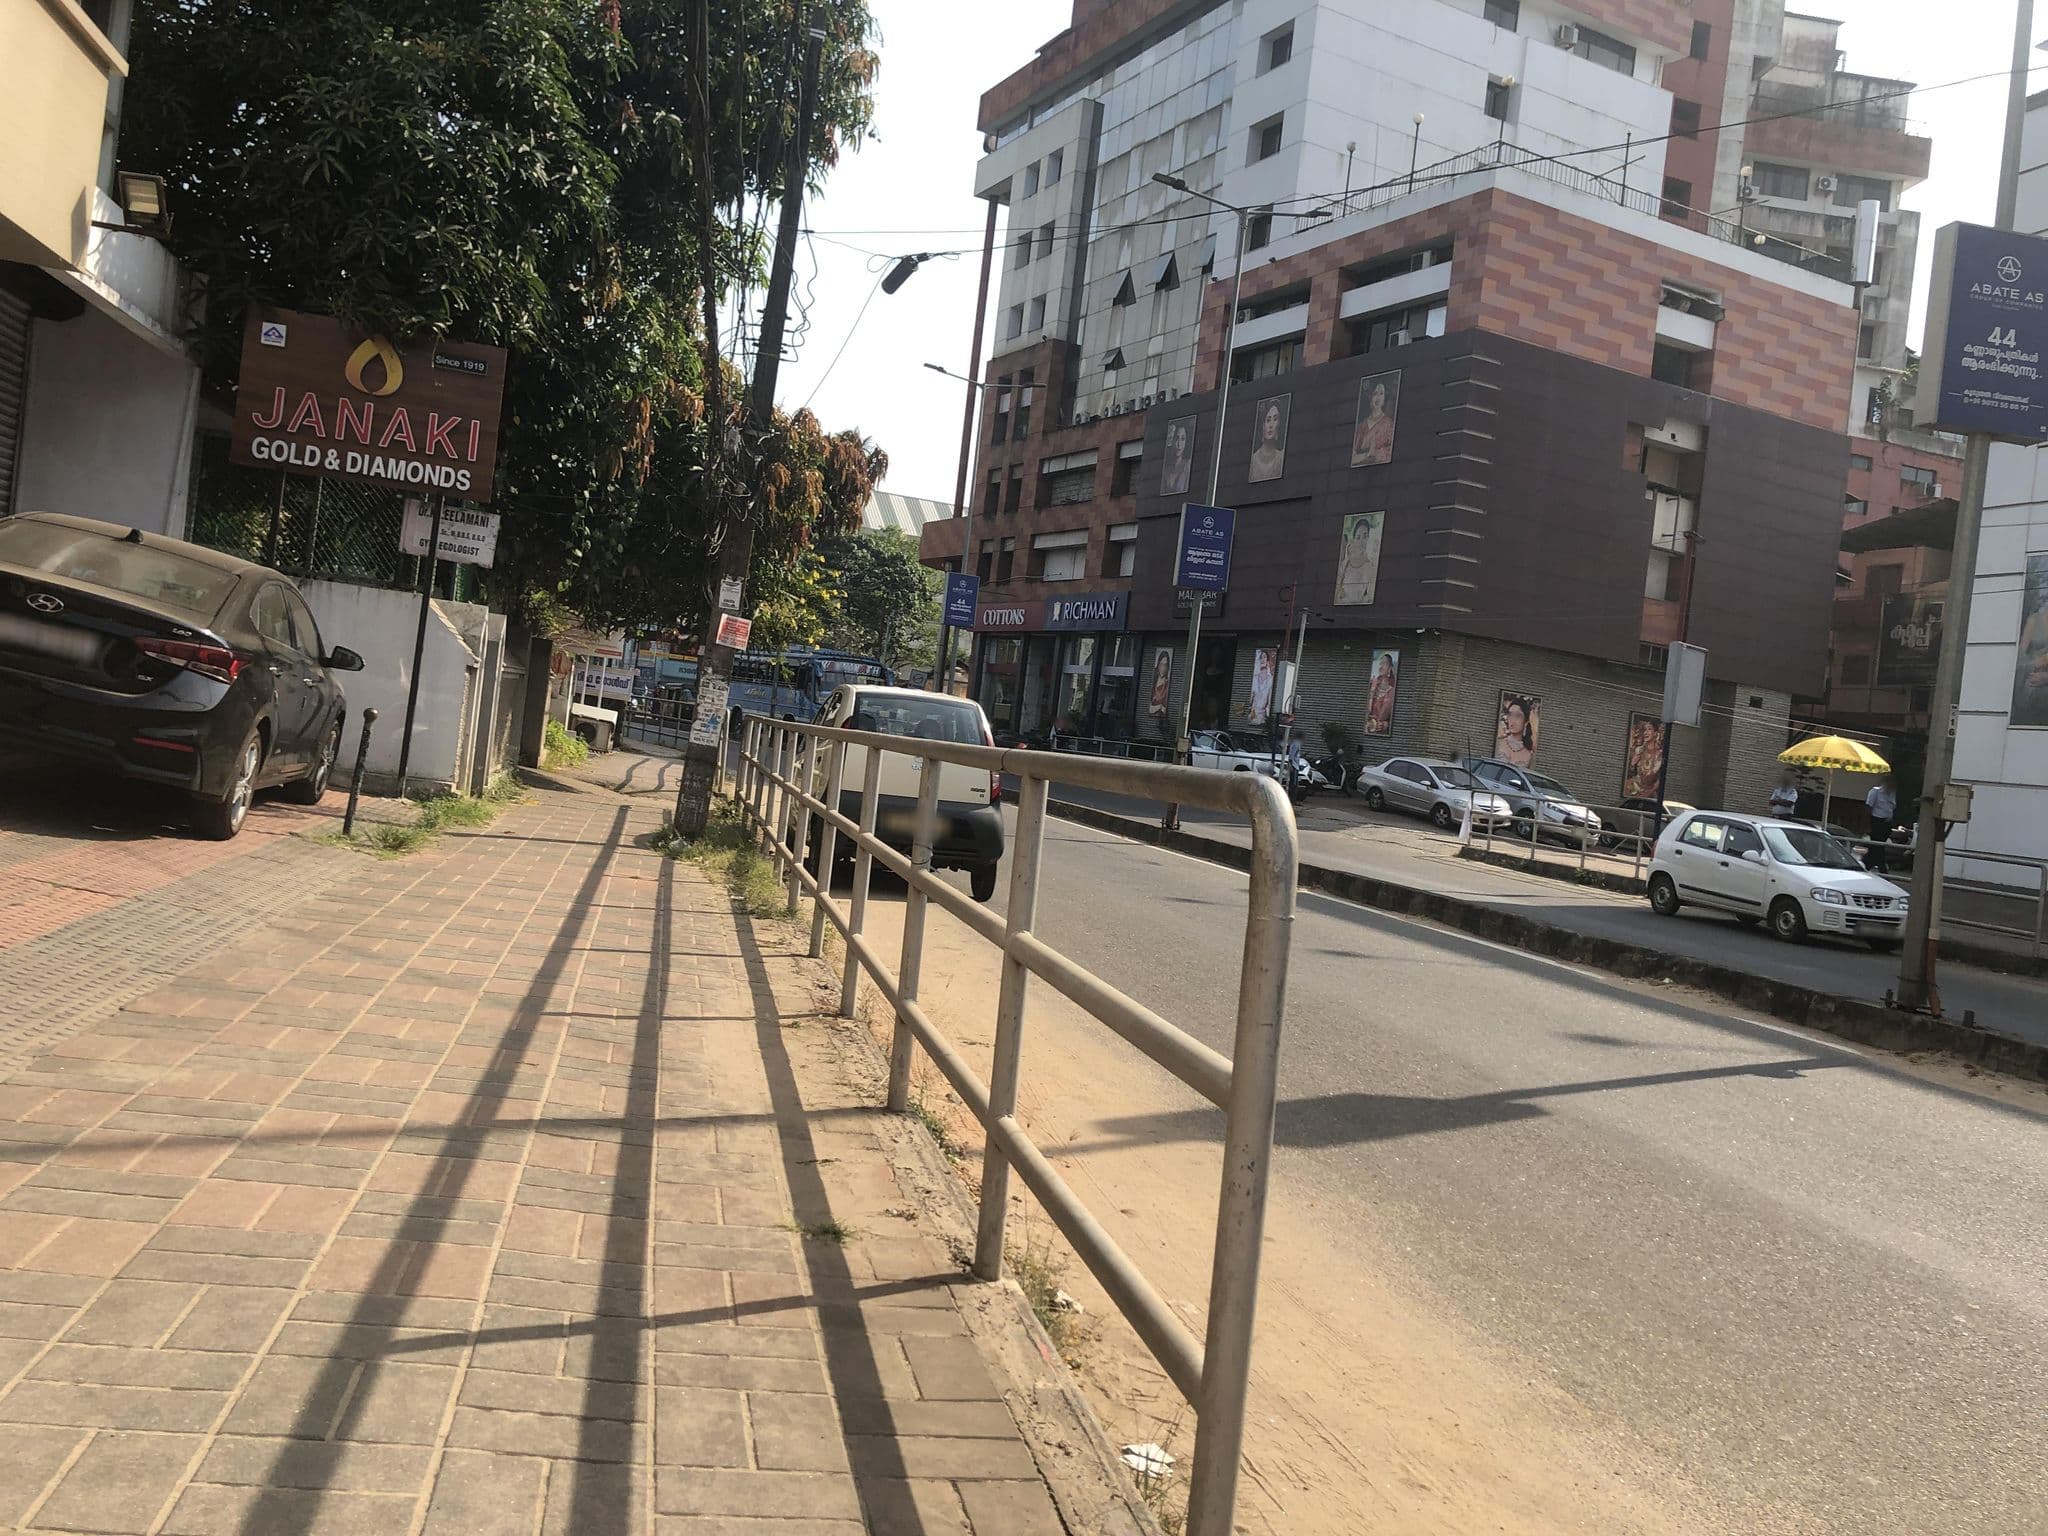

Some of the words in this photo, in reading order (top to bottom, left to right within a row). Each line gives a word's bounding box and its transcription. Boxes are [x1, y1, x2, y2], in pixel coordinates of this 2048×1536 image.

[1970, 282, 2020, 300] ABATE
[2025, 292, 2045, 304] AS
[1987, 326, 2016, 348] 44
[435, 354, 460, 367] Since
[463, 361, 485, 371] 1919
[252, 386, 480, 462] JANAKI
[251, 436, 321, 467] GOLD
[323, 448, 341, 471] &
[345, 451, 472, 491] DIAMONDS
[419, 538, 480, 557] GYECOLOGIST
[983, 608, 1026, 626] COTTONS
[1063, 600, 1116, 620] RICHMAN
